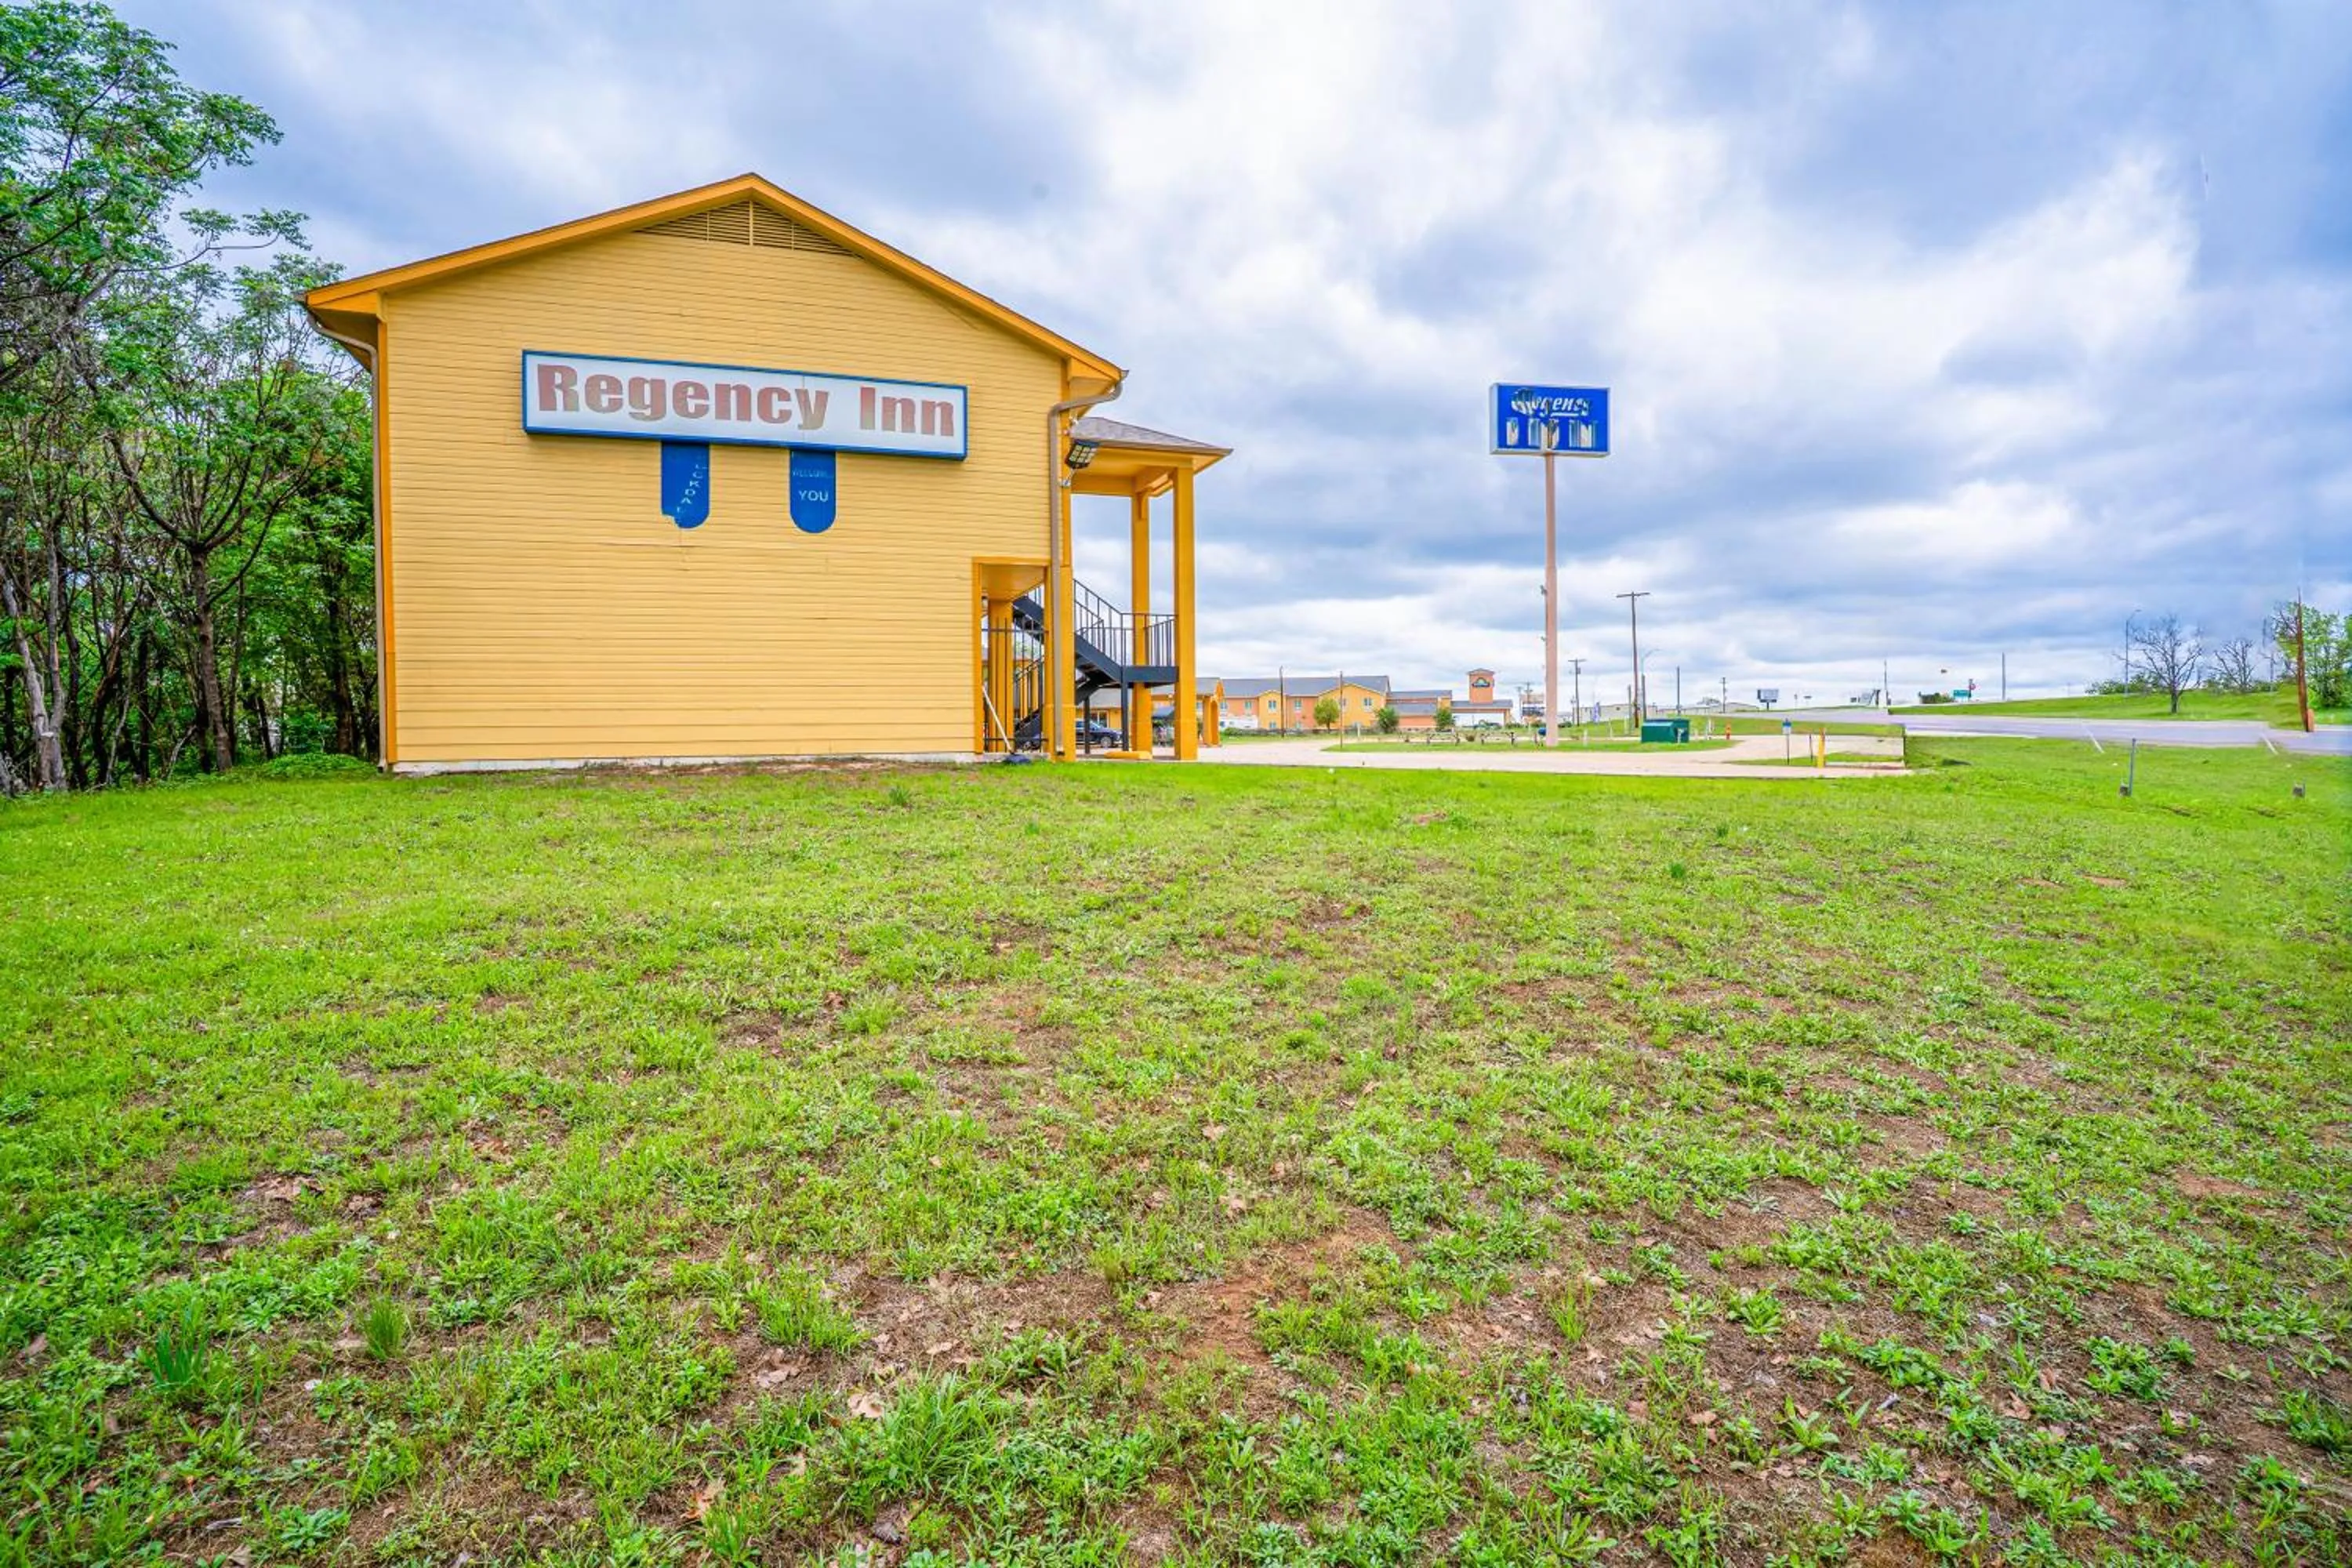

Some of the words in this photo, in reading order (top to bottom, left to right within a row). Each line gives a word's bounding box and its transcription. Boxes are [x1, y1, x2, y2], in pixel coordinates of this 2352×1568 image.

[537, 363, 829, 430] Regency
[860, 386, 954, 437] Inn
[798, 489, 829, 503] YOU
